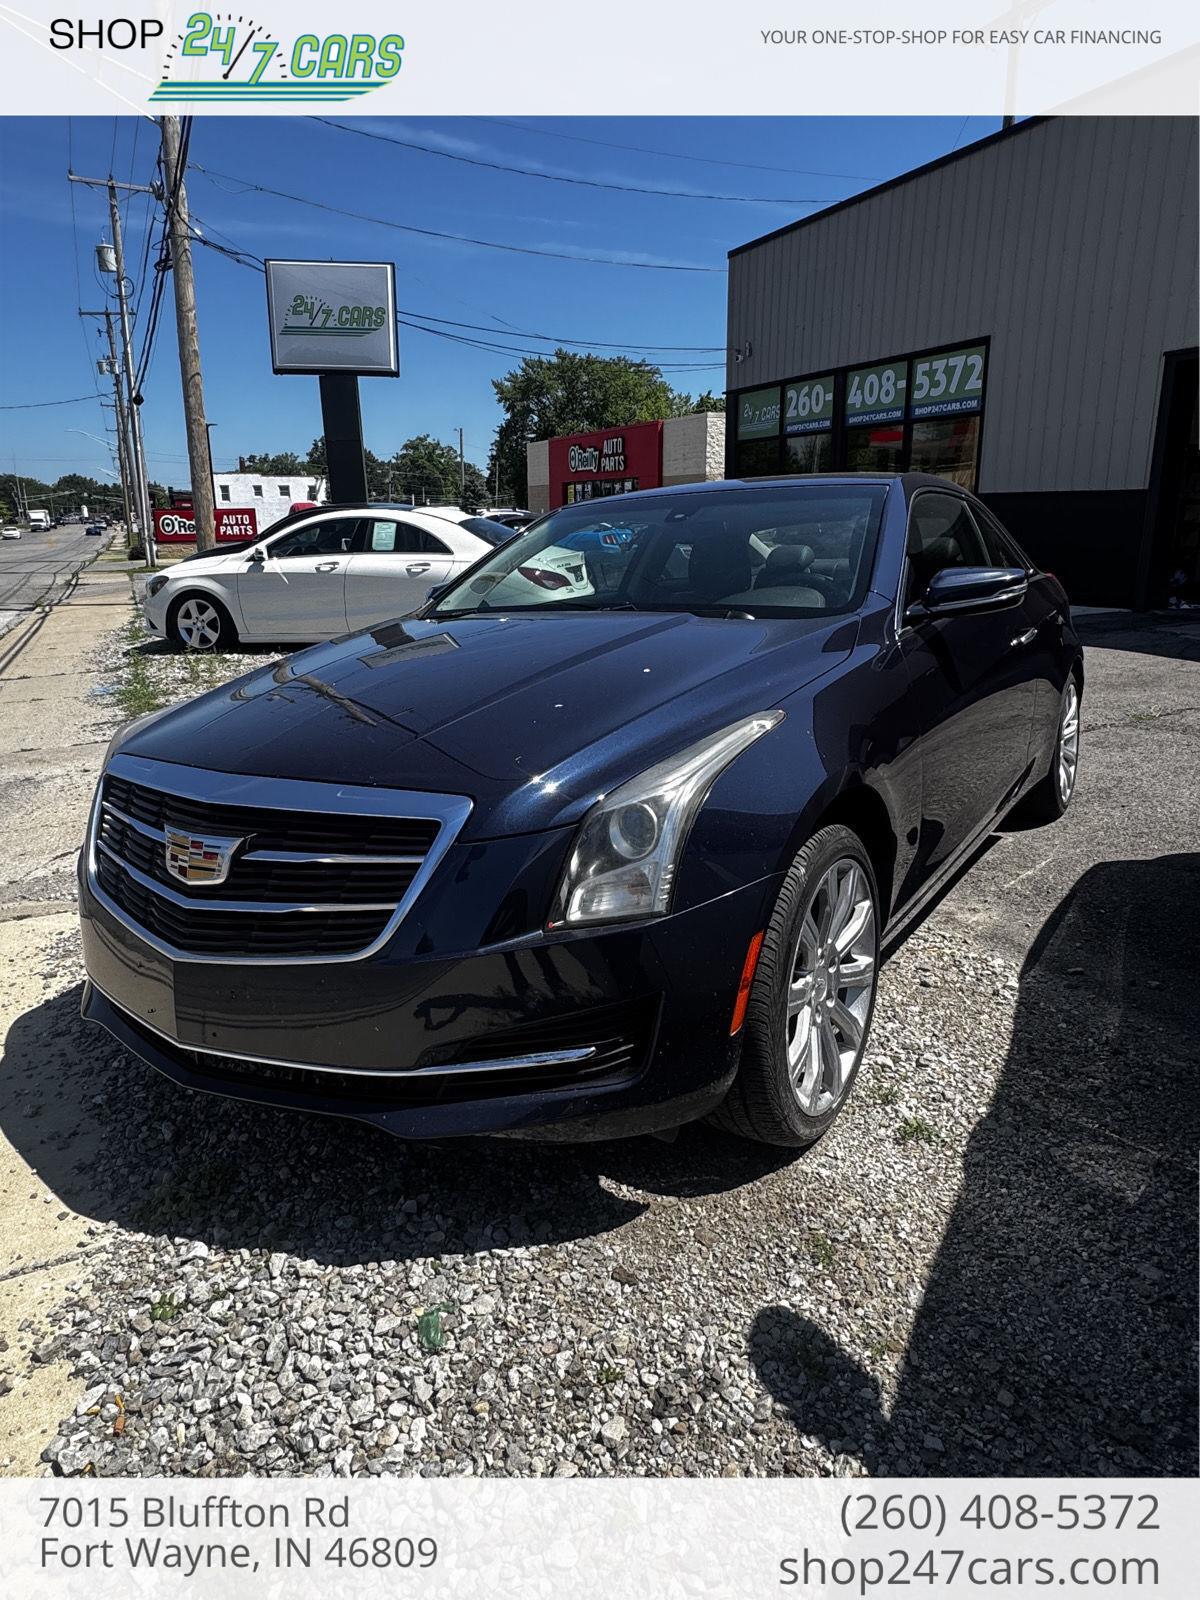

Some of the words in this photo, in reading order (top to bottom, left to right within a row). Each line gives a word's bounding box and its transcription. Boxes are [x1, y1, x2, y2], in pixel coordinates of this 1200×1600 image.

[337, 305, 386, 327] CARS
[913, 354, 983, 399] 5372
[914, 399, 978, 416] SHOP247CARS.COM
[848, 410, 902, 424] SHOP247CARS.COM
[603, 438, 623, 454] AUTO
[568, 446, 599, 473] O'Reilly
[600, 455, 625, 472] PARTS
[222, 514, 250, 525] AUTO
[219, 525, 254, 536] PARTS
